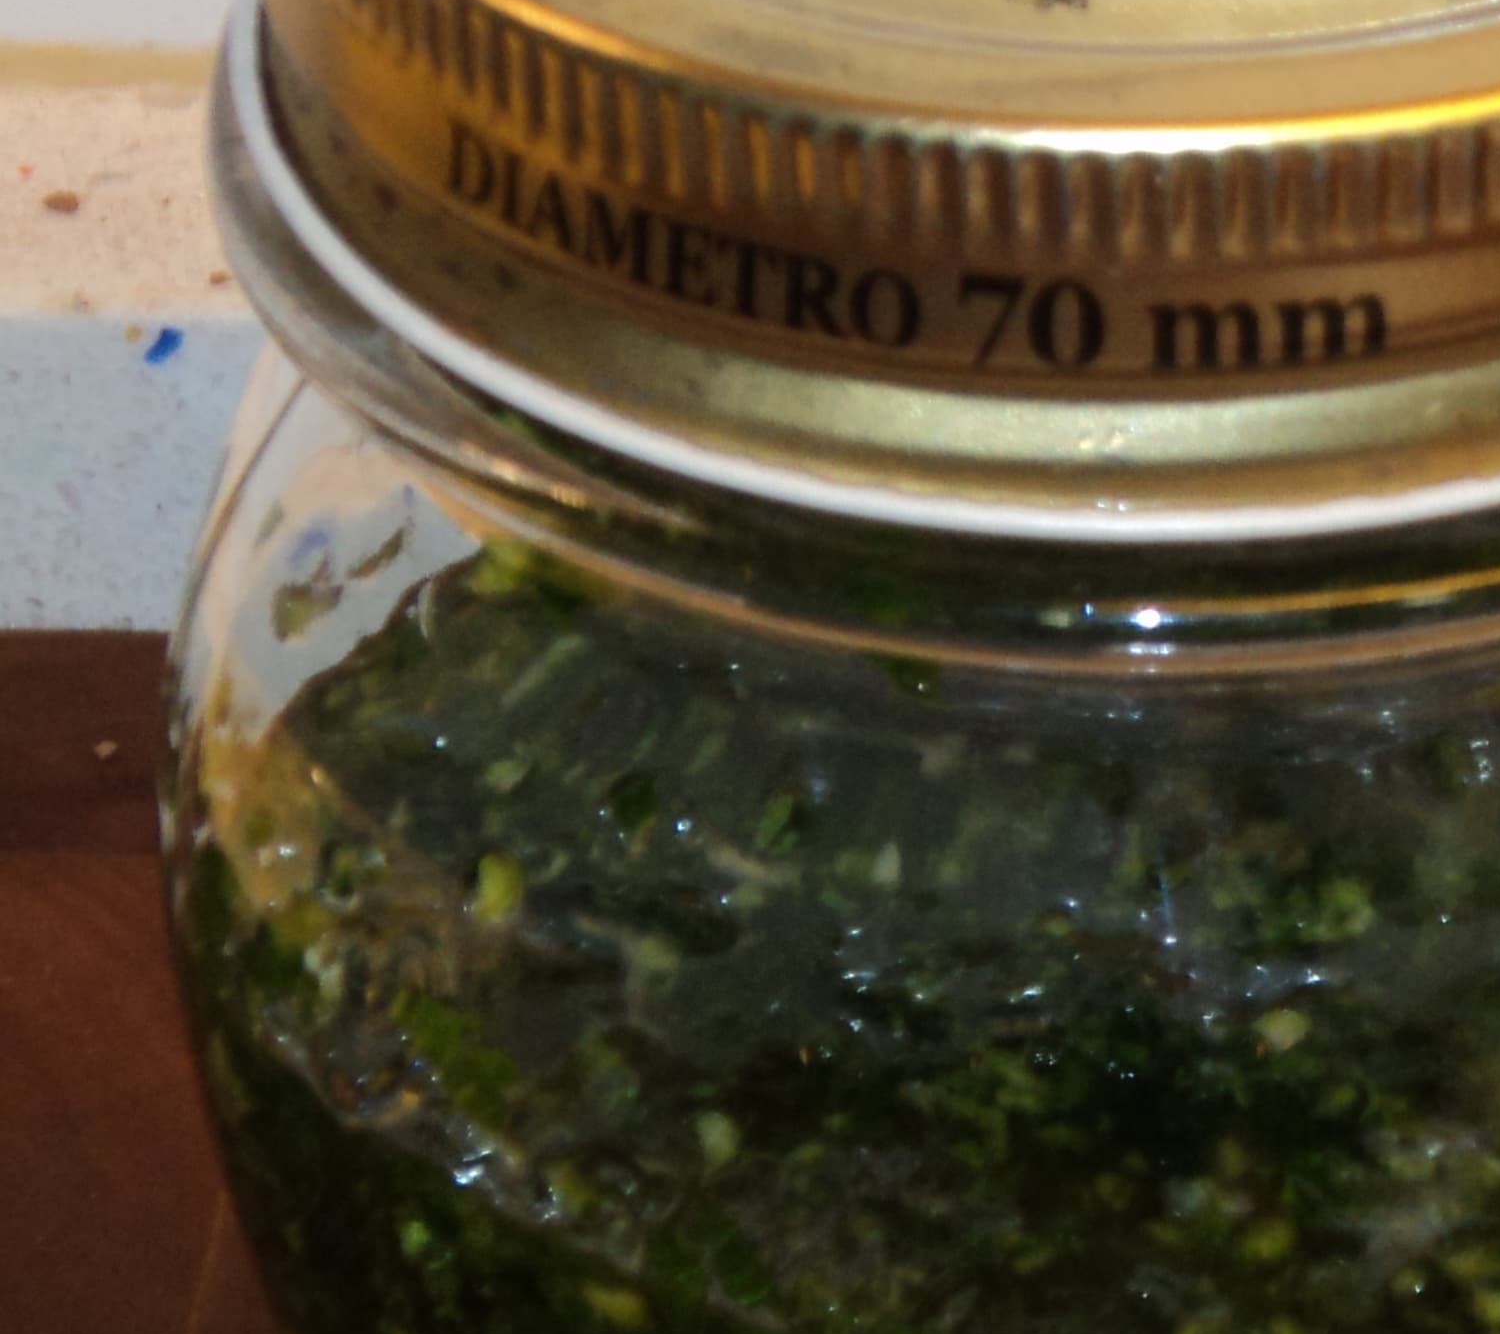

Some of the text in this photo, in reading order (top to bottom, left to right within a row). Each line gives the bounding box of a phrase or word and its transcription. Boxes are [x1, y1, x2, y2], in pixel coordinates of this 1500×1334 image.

[443, 119, 1390, 372] DIAMETRO 70 mm
